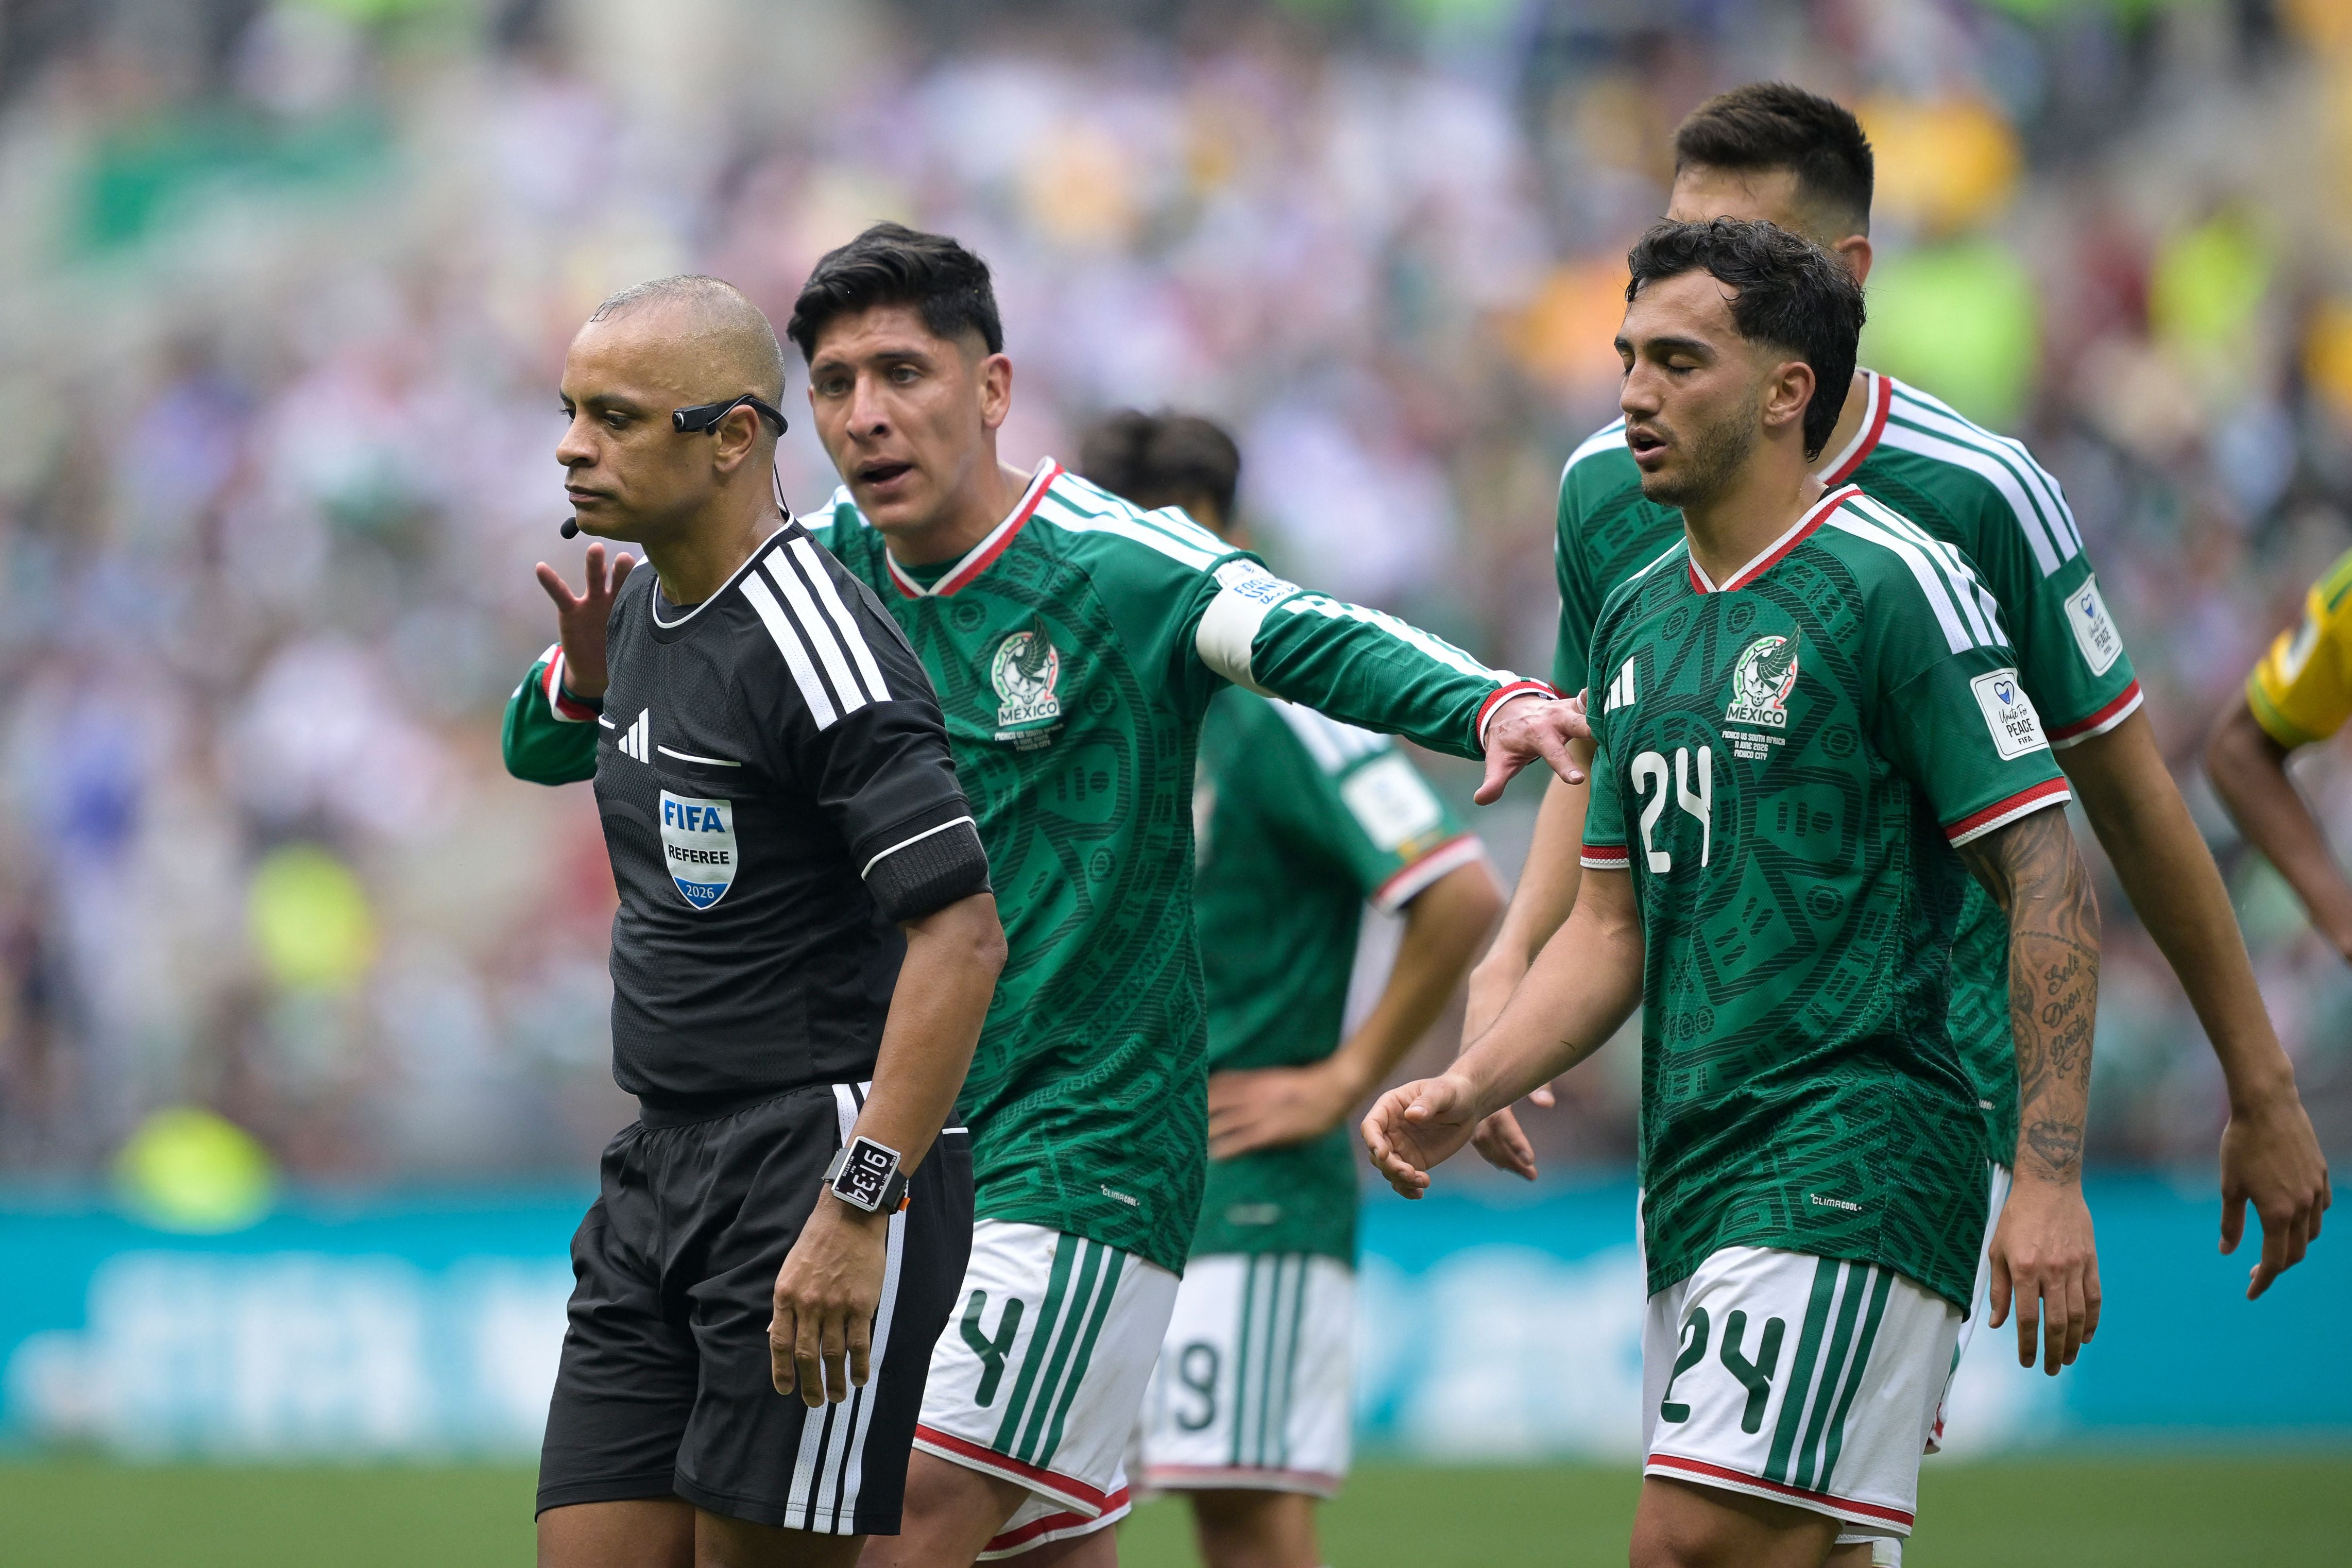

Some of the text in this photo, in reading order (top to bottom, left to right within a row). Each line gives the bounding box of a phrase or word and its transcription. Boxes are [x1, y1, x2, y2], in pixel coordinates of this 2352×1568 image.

[1000, 702, 1058, 723] MÉXICO
[1727, 705, 1784, 725] MÉXICO
[1999, 704, 2027, 724] Unite For
[1722, 730, 1740, 739] MEXICO
[1748, 734, 1765, 743] SOUTH
[1766, 736, 1785, 745] AFRICA
[2006, 718, 2035, 738] PEACE
[1739, 741, 1752, 749] JUNE
[1753, 743, 1768, 752] 2026
[2018, 735, 2033, 745] FIFA
[1734, 749, 1767, 760] MEXICO CITY
[664, 799, 725, 832] FIFA
[1631, 745, 1711, 873] 24
[668, 844, 730, 864] REFEREE
[686, 884, 714, 899] 2026
[846, 1149, 888, 1203] 91:34
[960, 1289, 1025, 1408] 4
[1661, 1306, 1786, 1435] 24
